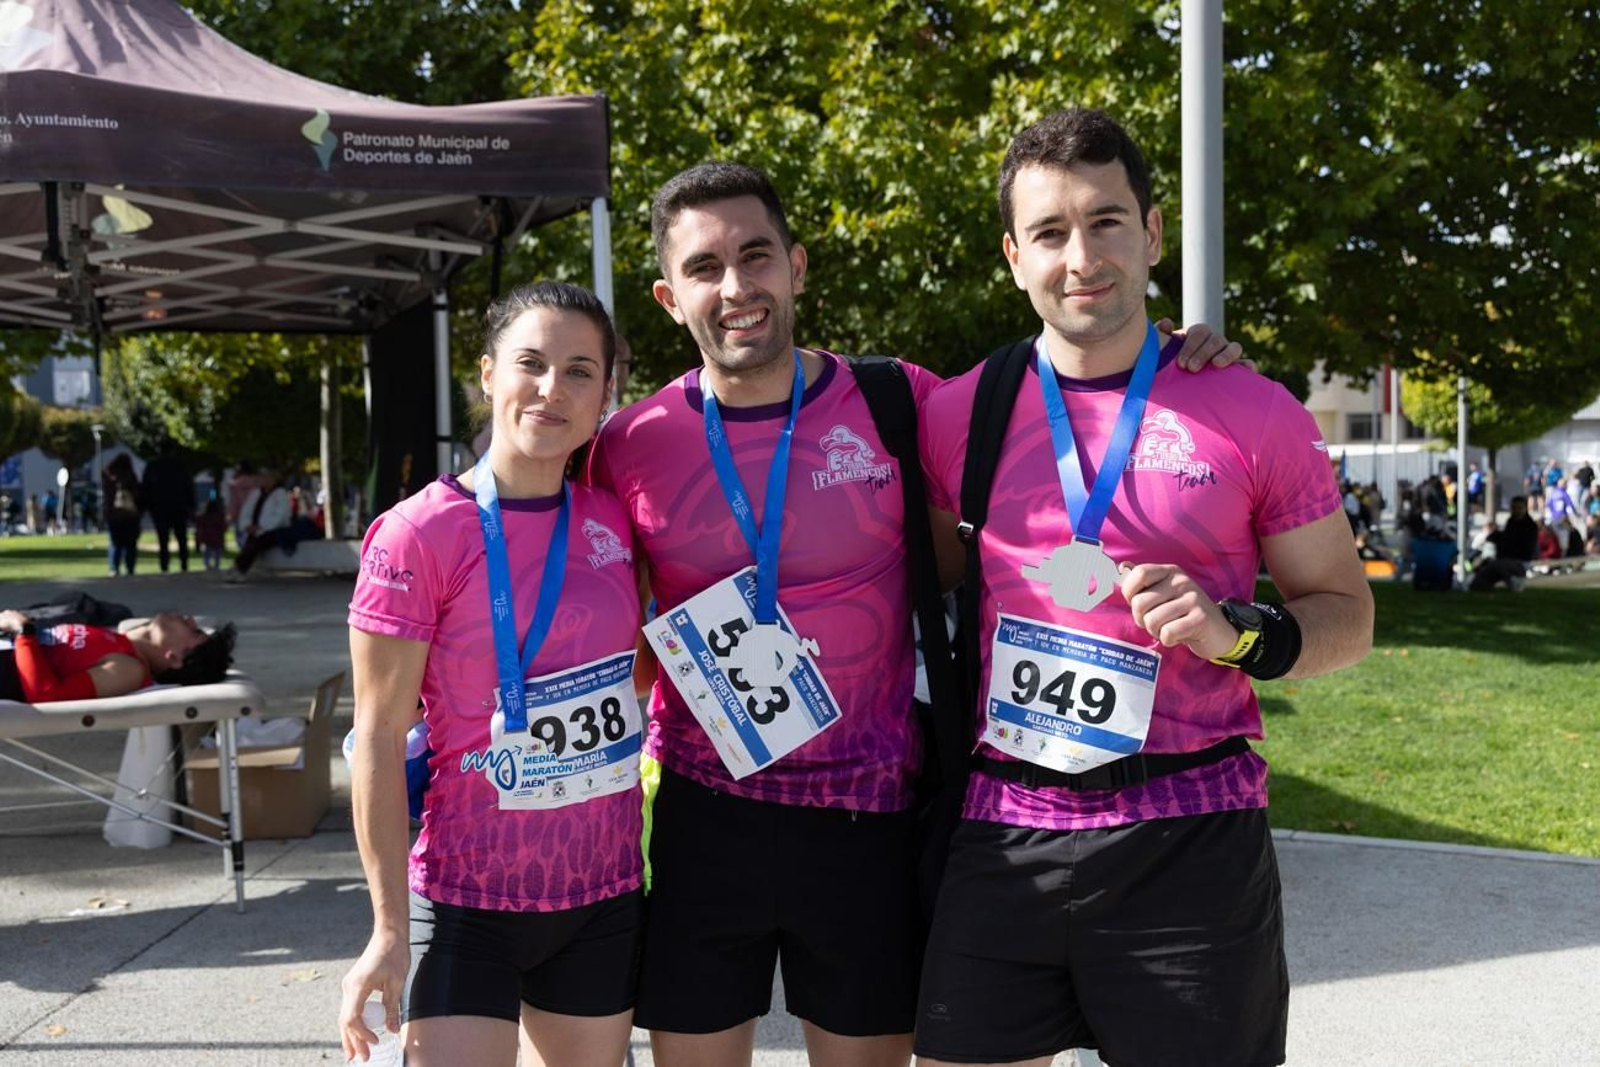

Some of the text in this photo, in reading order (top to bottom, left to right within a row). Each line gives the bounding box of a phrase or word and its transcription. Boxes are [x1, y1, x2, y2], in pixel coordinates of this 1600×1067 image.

[15, 112, 119, 129] Ayuntamiento
[342, 131, 511, 150] Patronato Municipal de
[343, 148, 473, 165] Deportes de Jaén
[1011, 659, 1116, 725] 949
[531, 697, 626, 758] 938
[1024, 711, 1083, 736] ALEJANDRO
[523, 753, 557, 766] MEDIA
[573, 750, 608, 768] MARÍA
[519, 777, 546, 790] JAÉN
